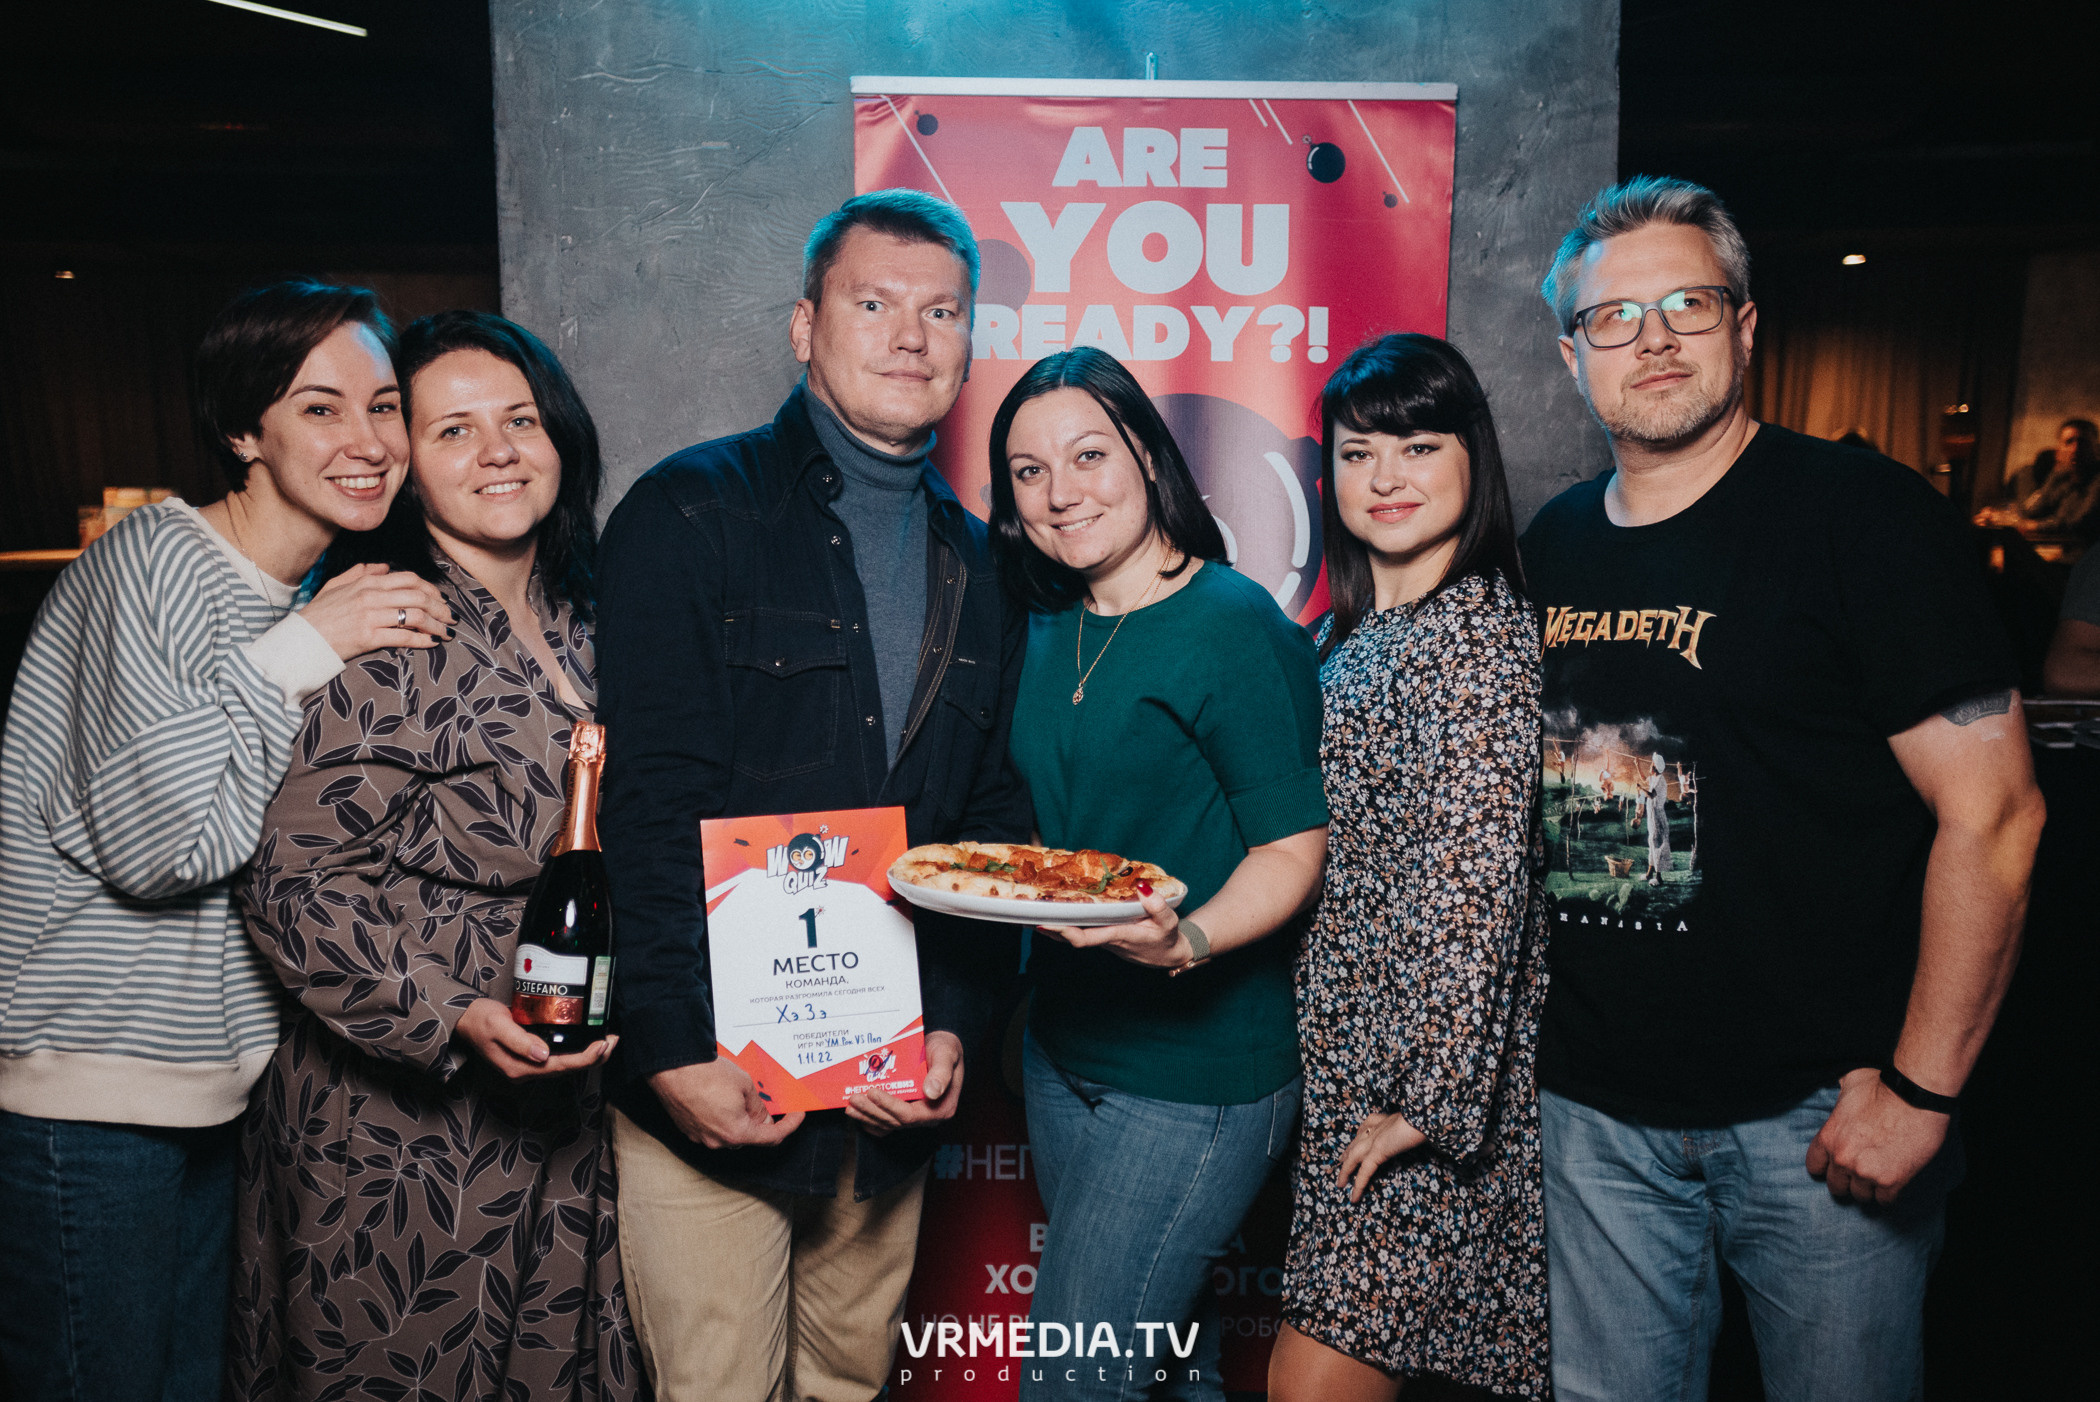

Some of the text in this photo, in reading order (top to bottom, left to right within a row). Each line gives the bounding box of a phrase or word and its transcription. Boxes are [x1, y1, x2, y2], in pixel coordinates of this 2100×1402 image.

[1052, 126, 1228, 188] ARE
[1001, 200, 1289, 295] YOU
[972, 305, 1329, 364] READY?!
[1538, 606, 1717, 670] MEGADETH
[783, 866, 828, 895] QUIZ
[798, 907, 818, 949] 1
[773, 951, 859, 975] МЕСТО
[522, 981, 568, 995] STEFANO
[750, 985, 885, 1004] КОТОРАЯ РАЗГРОМИЛА СЕГОДНЯ ВСЕХ
[793, 1029, 849, 1041] ПОБЕДИТЕЛИ
